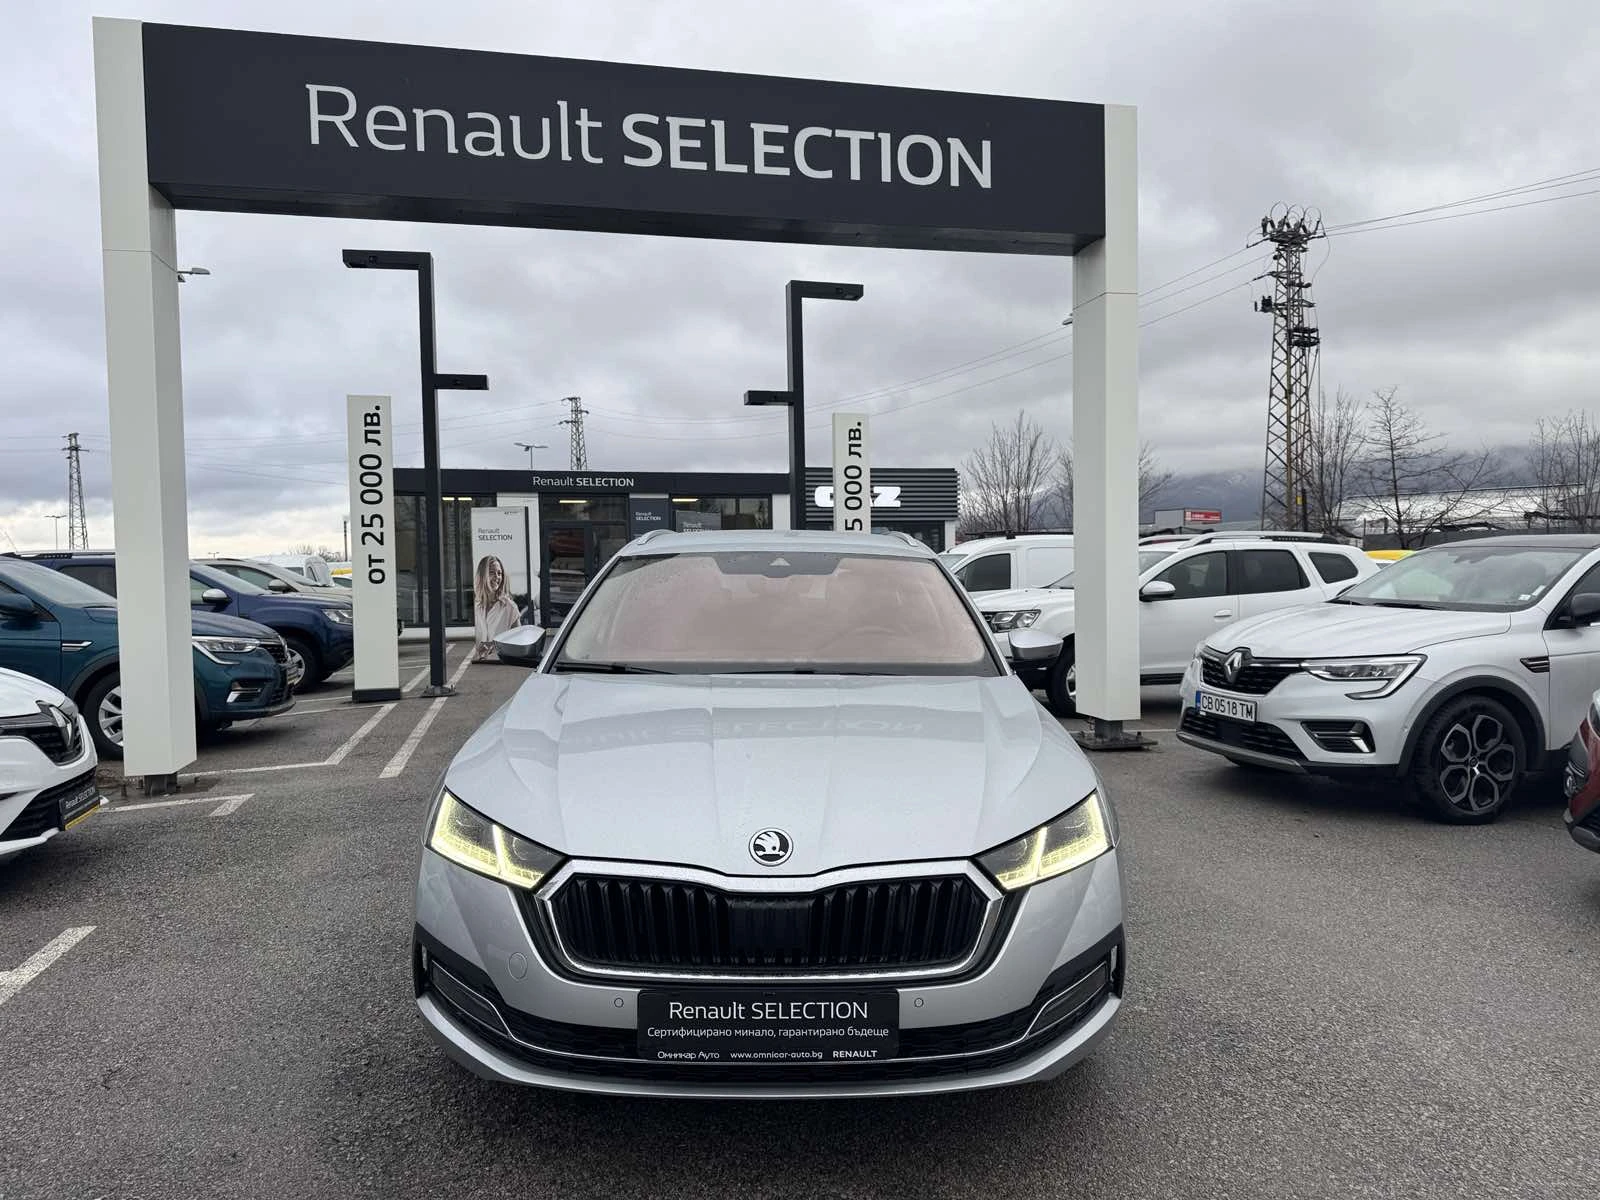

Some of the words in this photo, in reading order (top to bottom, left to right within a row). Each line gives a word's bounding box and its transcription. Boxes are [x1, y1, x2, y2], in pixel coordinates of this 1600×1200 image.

[305, 83, 603, 165] Renault
[622, 112, 992, 189] SELECTION
[364, 405, 382, 446] лв.
[848, 422, 862, 458] лв.
[359, 454, 383, 505] 000
[532, 476, 574, 487] Renault
[576, 477, 634, 487] SELECTION
[844, 465, 862, 511] 000
[361, 514, 384, 546] 25
[368, 554, 386, 584] от
[1202, 695, 1213, 711] CB
[1214, 698, 1238, 716] 0518
[1239, 703, 1253, 719] TM
[669, 1001, 746, 1020] Renault
[751, 1001, 868, 1020] SELECTION
[647, 1026, 732, 1039] Сертифицирано
[734, 1027, 776, 1038] минало,
[778, 1027, 845, 1039] гарантирано
[847, 1026, 889, 1038] бъдеще
[657, 1050, 697, 1060] Омникар
[698, 1050, 720, 1060] Ауто
[832, 1050, 878, 1058] RENAULT
